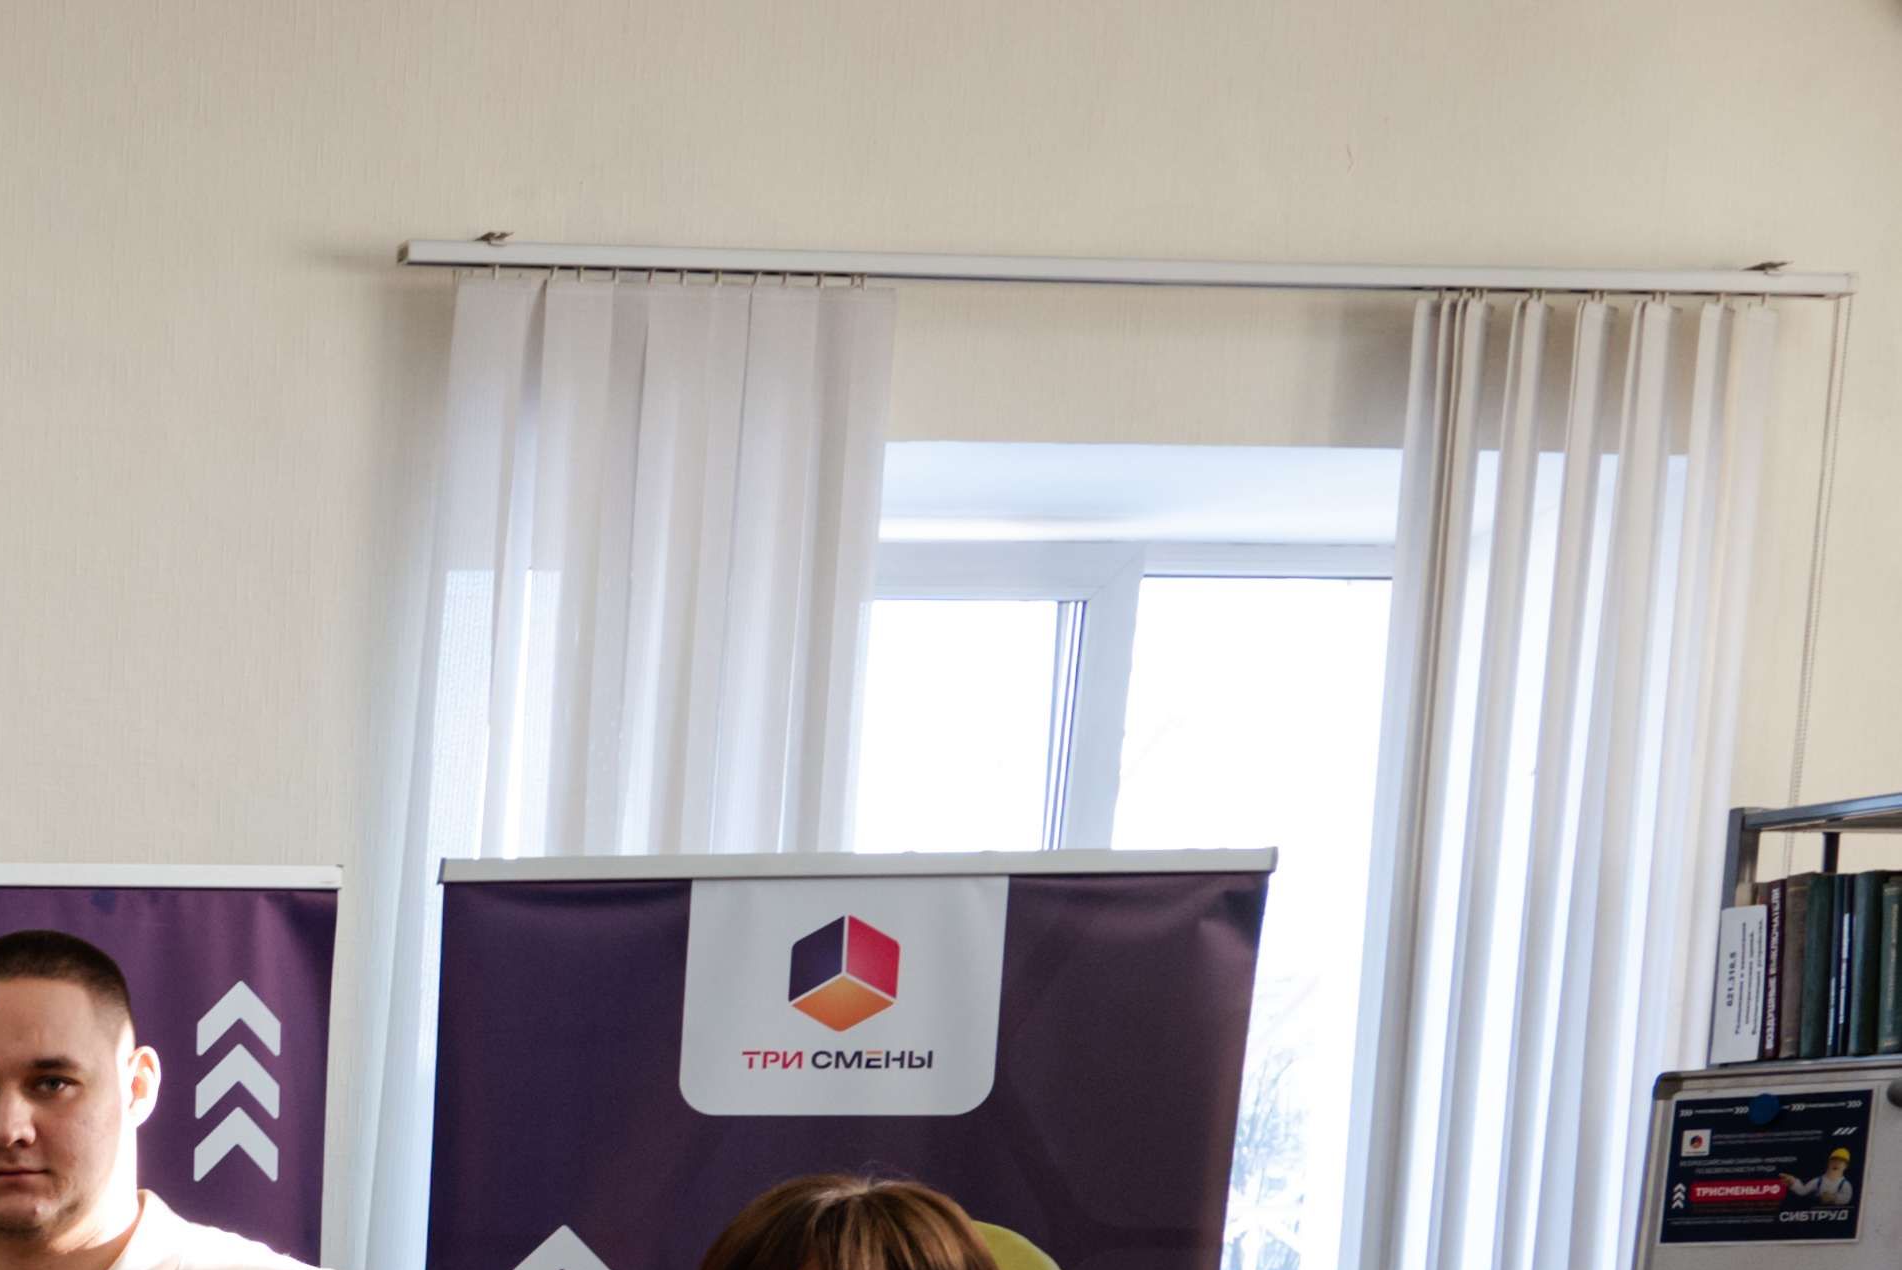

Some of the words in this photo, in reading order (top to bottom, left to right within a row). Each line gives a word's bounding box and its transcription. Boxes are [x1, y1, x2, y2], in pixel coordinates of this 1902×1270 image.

[742, 1050, 803, 1071] ТРИ
[810, 1050, 934, 1071] СМЕНЫ
[1695, 1185, 1780, 1197] ТРИСМЕНЫ.РФ
[1779, 1210, 1848, 1222] СИБТРУД
